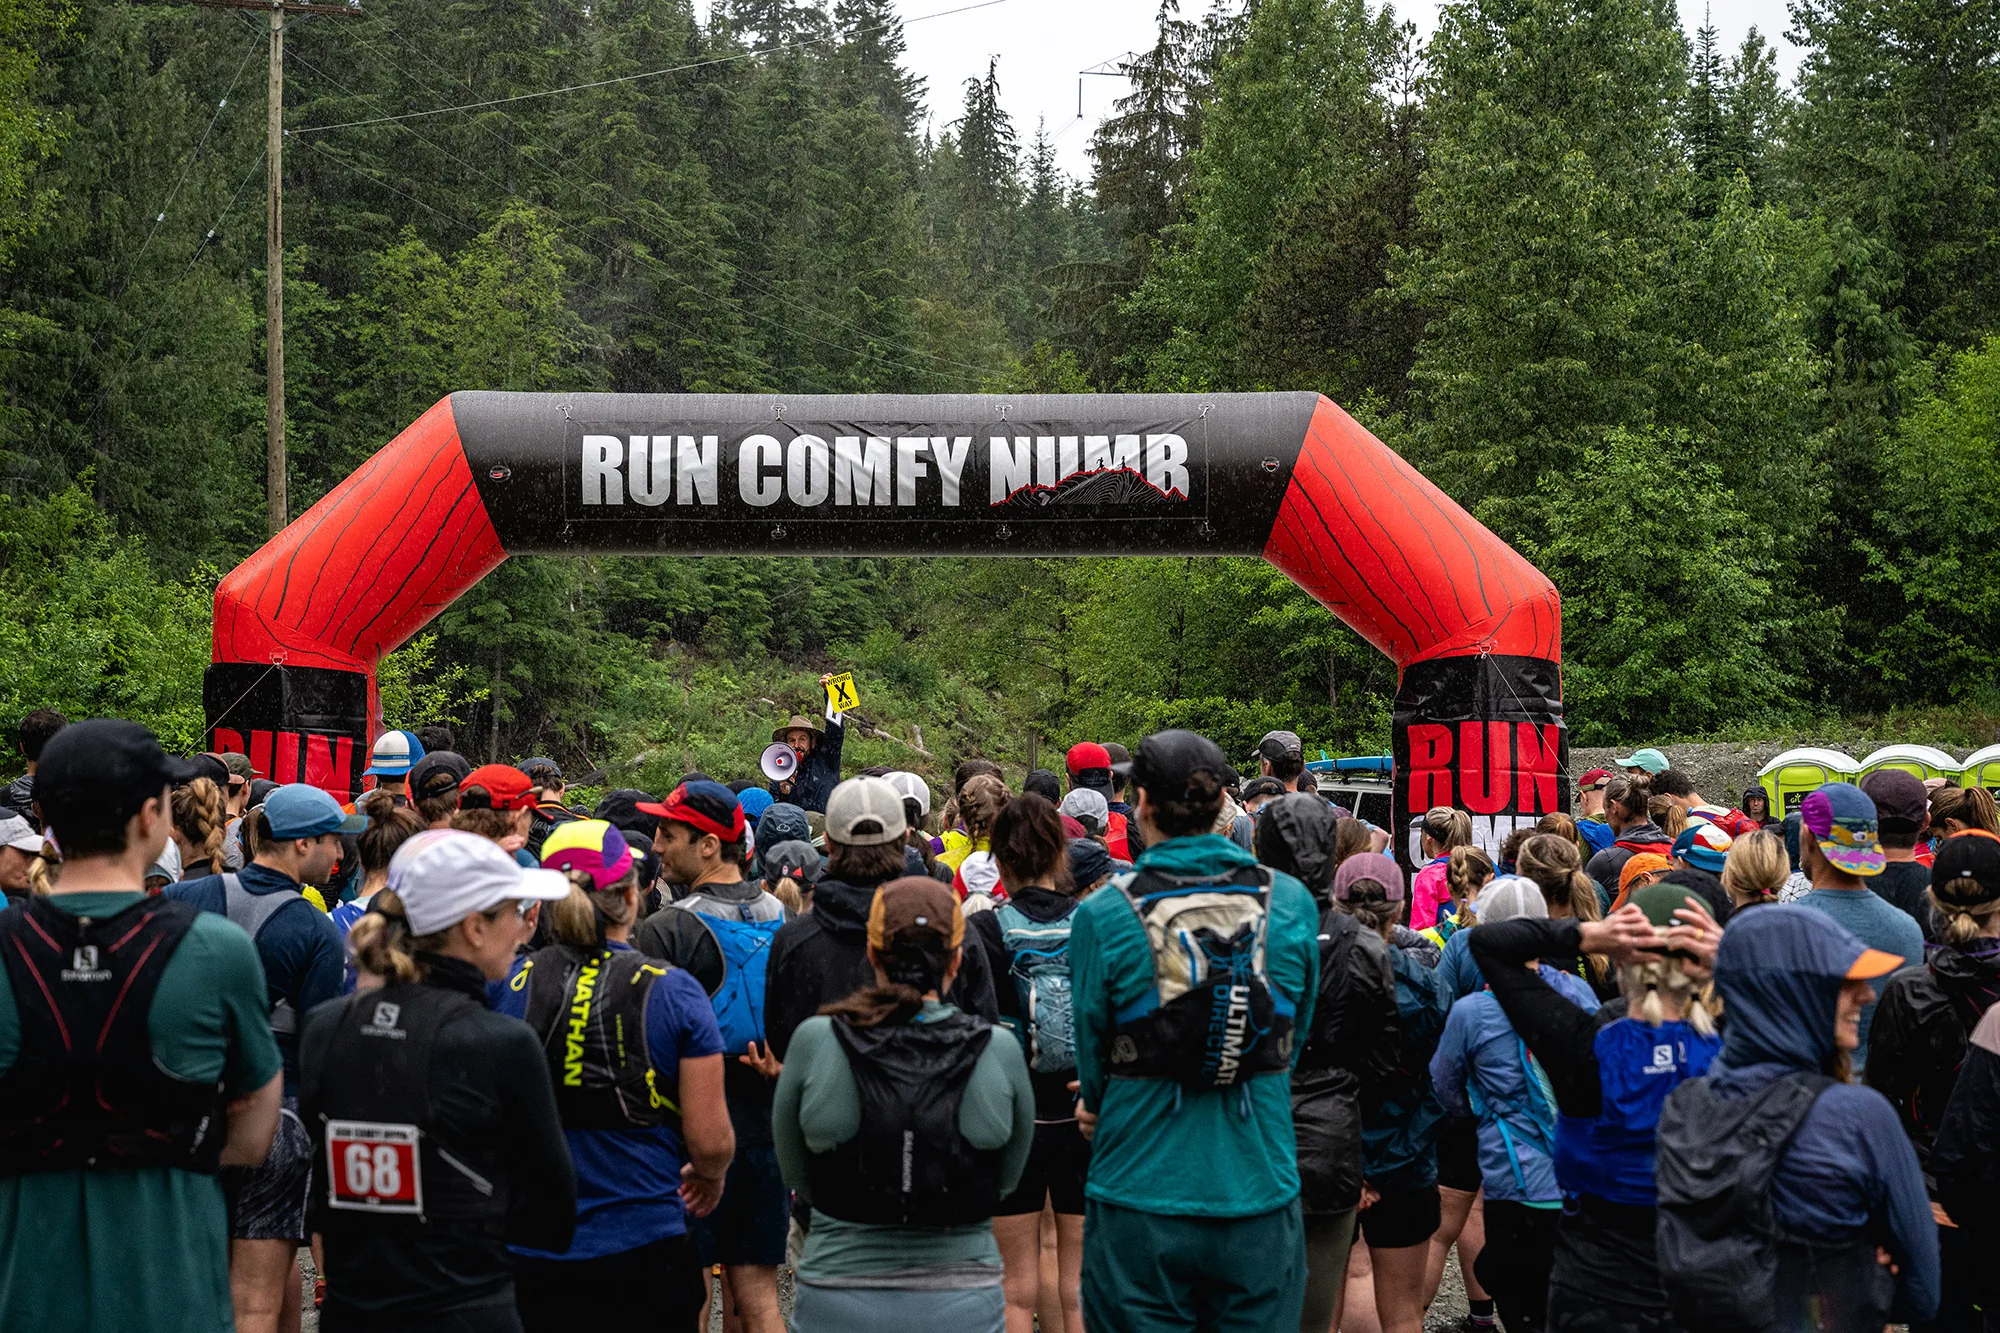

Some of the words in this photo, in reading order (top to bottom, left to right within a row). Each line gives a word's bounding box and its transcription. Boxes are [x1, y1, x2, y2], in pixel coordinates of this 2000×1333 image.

[582, 434, 719, 506] RUN
[738, 434, 973, 506] COMFY
[827, 673, 851, 686] WRONG
[838, 699, 853, 710] WAY
[1407, 720, 1560, 815] RUN
[563, 965, 599, 1087] NATHAN
[1200, 984, 1230, 1082] DIRECTIO
[344, 1142, 402, 1197] 68
